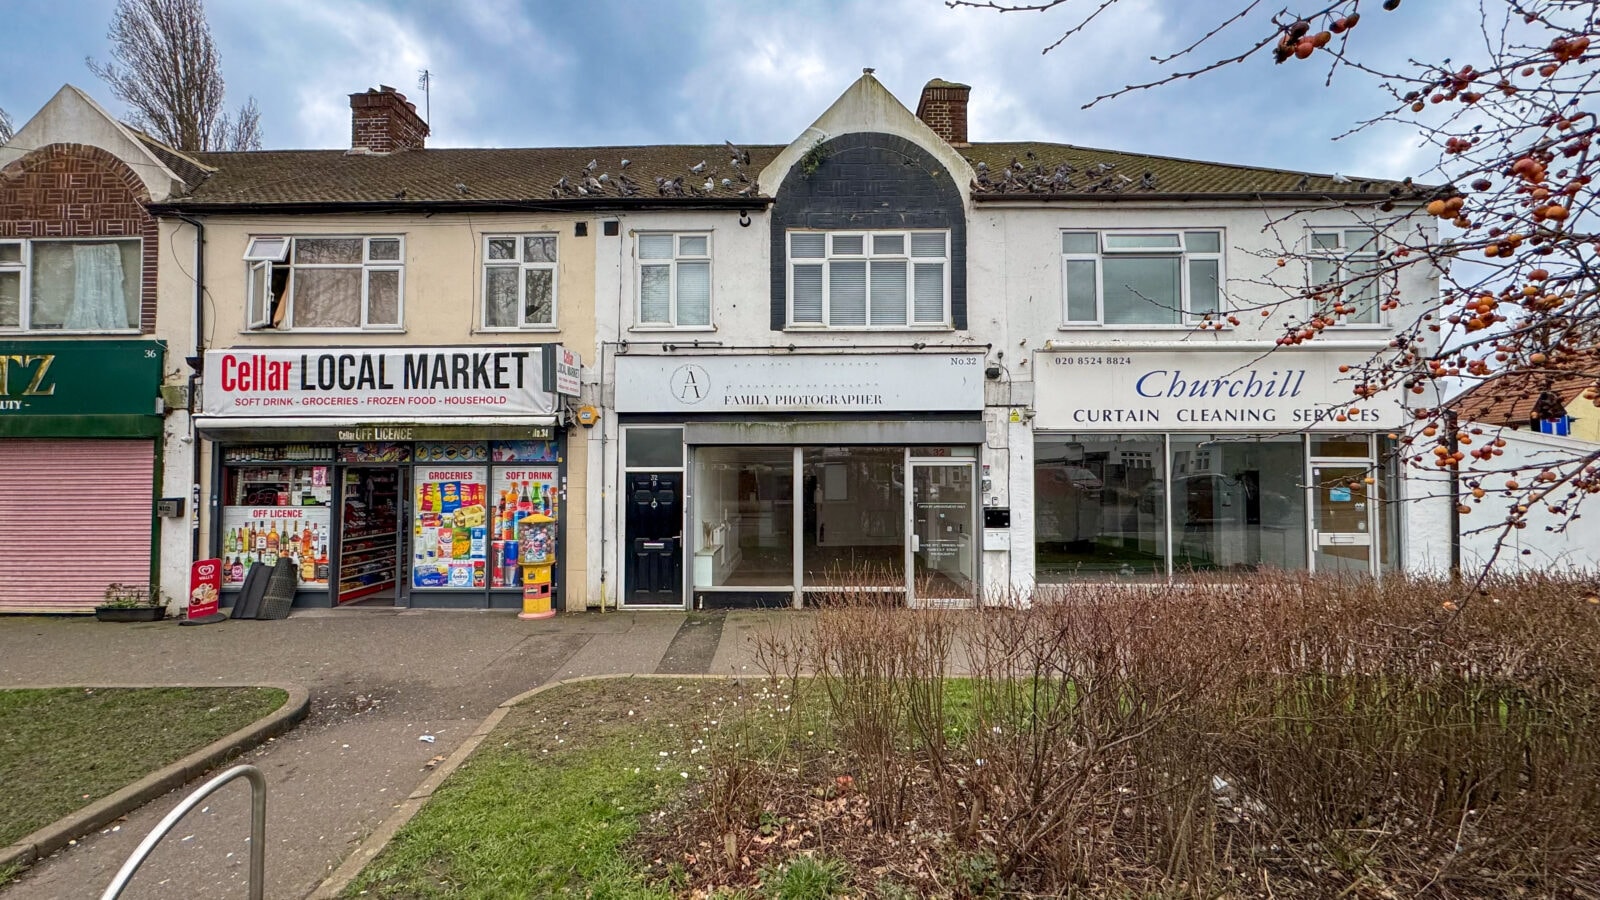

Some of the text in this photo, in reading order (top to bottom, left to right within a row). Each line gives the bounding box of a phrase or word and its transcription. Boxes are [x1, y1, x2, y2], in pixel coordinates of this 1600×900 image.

[144, 350, 157, 358] 36
[950, 357, 977, 366] No.32
[1055, 357, 1131, 365] 020 8524 8824
[221, 352, 529, 392] Cellar LOCAL MARKET
[1135, 370, 1305, 398] Churchill
[235, 397, 261, 406] SOFT
[263, 397, 294, 406] DRINK
[302, 397, 359, 406] GROCERIES
[367, 396, 406, 405] FROZEN
[408, 396, 437, 405] FOOD
[444, 396, 507, 405] HOUSEHOLD
[724, 394, 883, 406] FAMILY PHOTOGRAPHER
[1073, 409, 1160, 423] CURTAIN
[1176, 408, 1276, 422] CLEANING
[338, 427, 413, 440] Cellar OFF LICENCE
[933, 448, 945, 456] 32
[428, 471, 473, 480] GROCERIES
[505, 471, 553, 480] SOFT DRINK
[253, 509, 303, 518] OFF LICENCE
